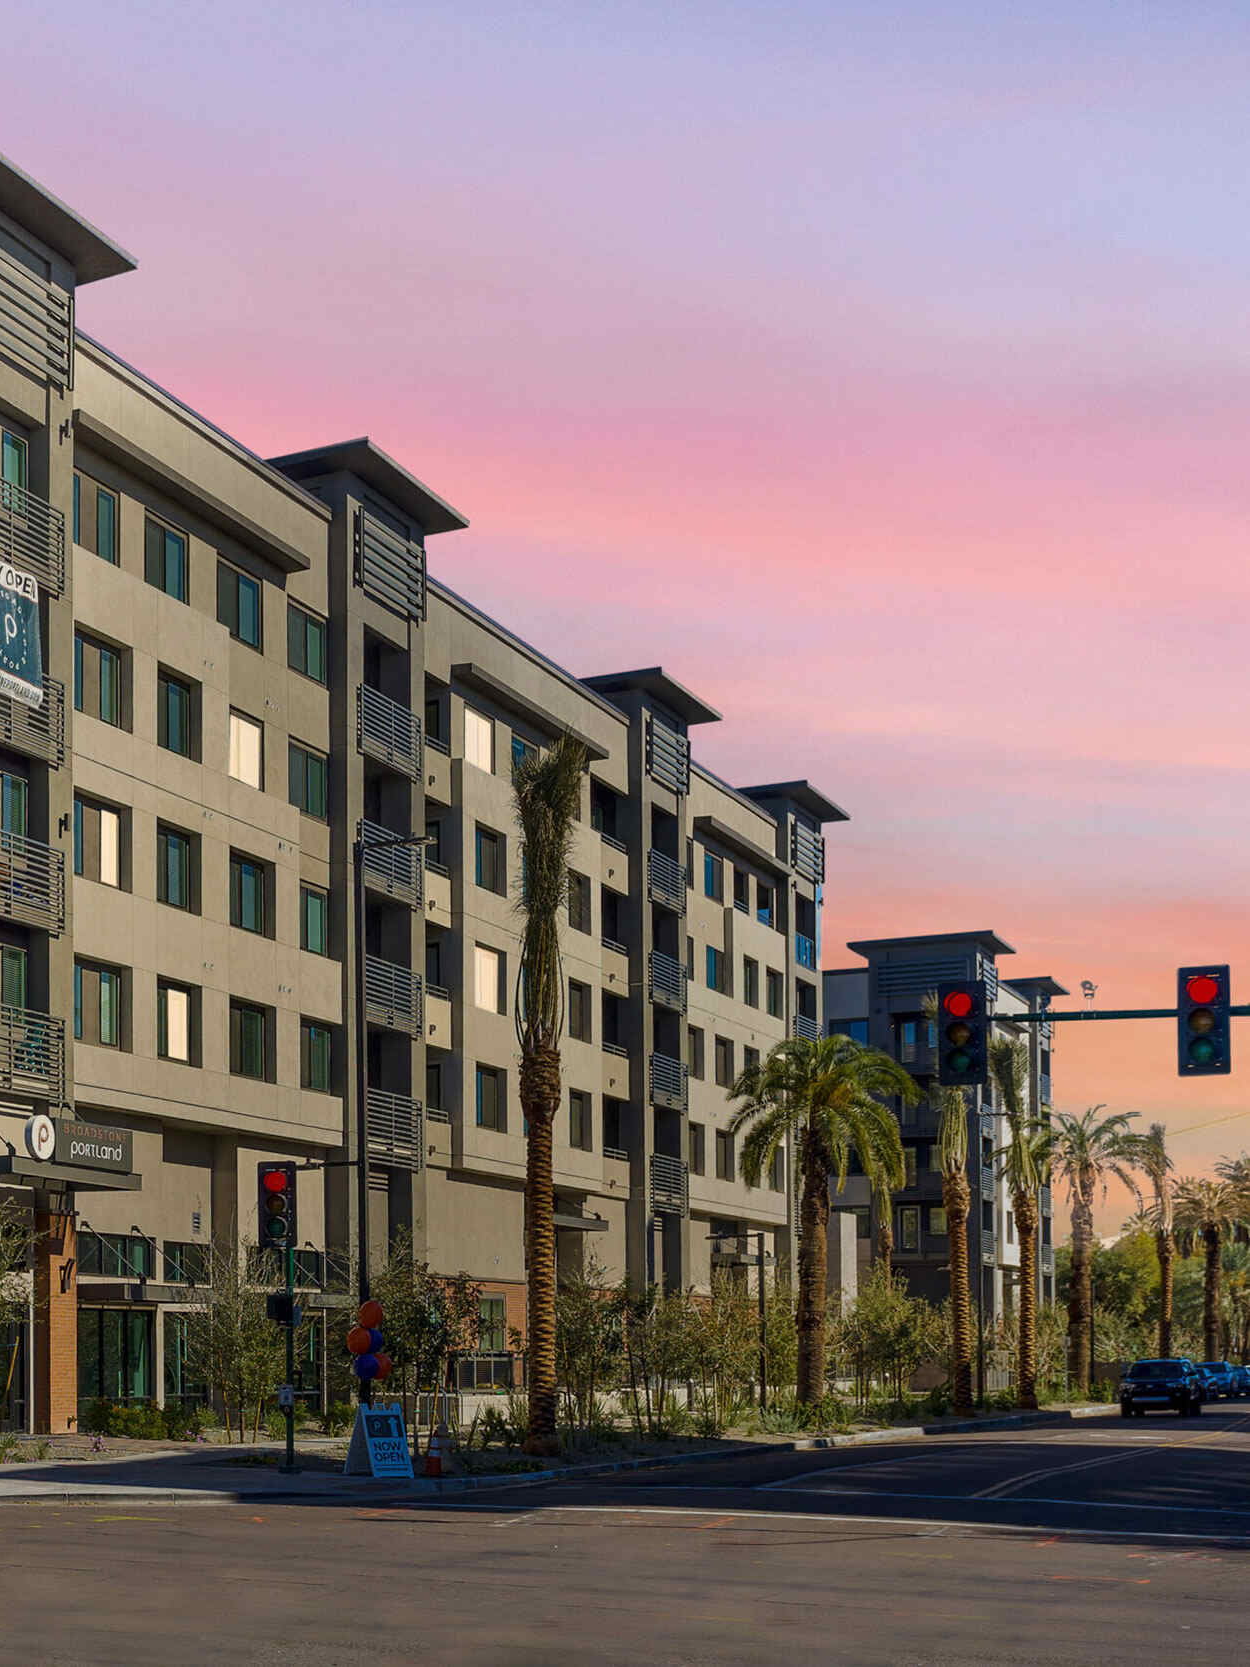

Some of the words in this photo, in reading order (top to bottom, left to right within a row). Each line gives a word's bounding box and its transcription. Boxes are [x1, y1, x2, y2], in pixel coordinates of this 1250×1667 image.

[6, 569, 37, 599] OPEN
[63, 1121, 127, 1144] BROADSTONE
[374, 1441, 400, 1451] NOW
[374, 1452, 405, 1464] OPEN
